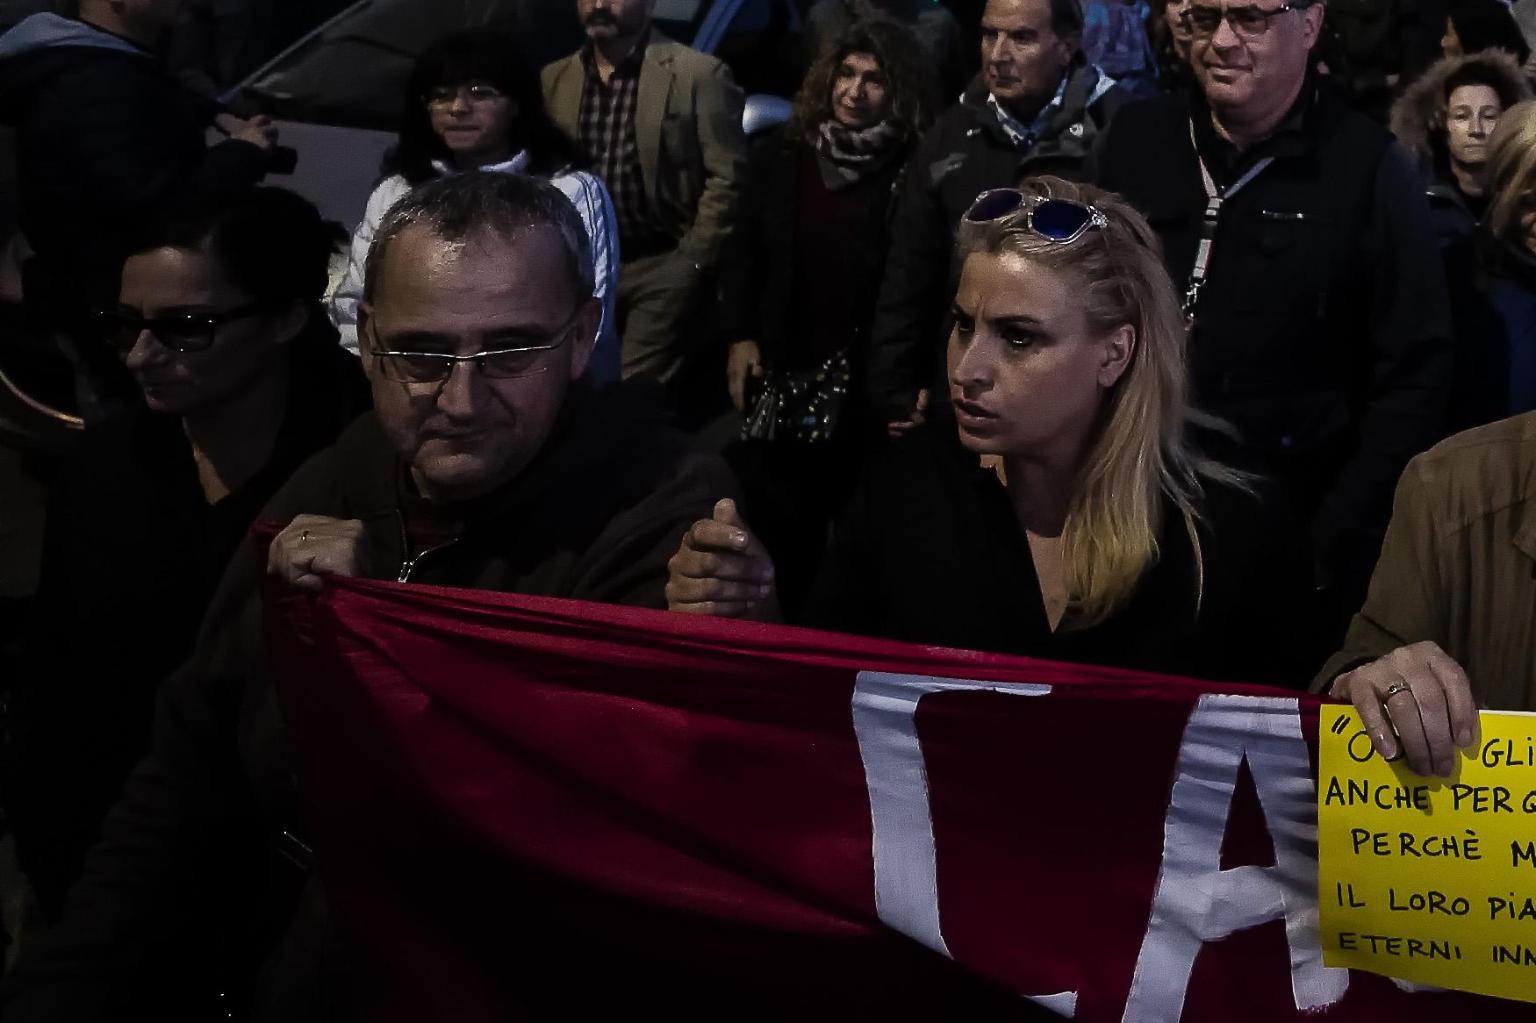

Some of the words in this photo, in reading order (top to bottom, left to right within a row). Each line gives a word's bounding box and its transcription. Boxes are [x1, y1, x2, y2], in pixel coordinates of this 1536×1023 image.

[1481, 736, 1535, 769] GLI
[1325, 778, 1430, 811] ANCHE
[1452, 784, 1512, 814] PER
[1351, 828, 1482, 861] PERCHÈ
[1337, 882, 1366, 909] IL
[1389, 888, 1471, 918] LORO
[1339, 932, 1463, 961] ETERNI
